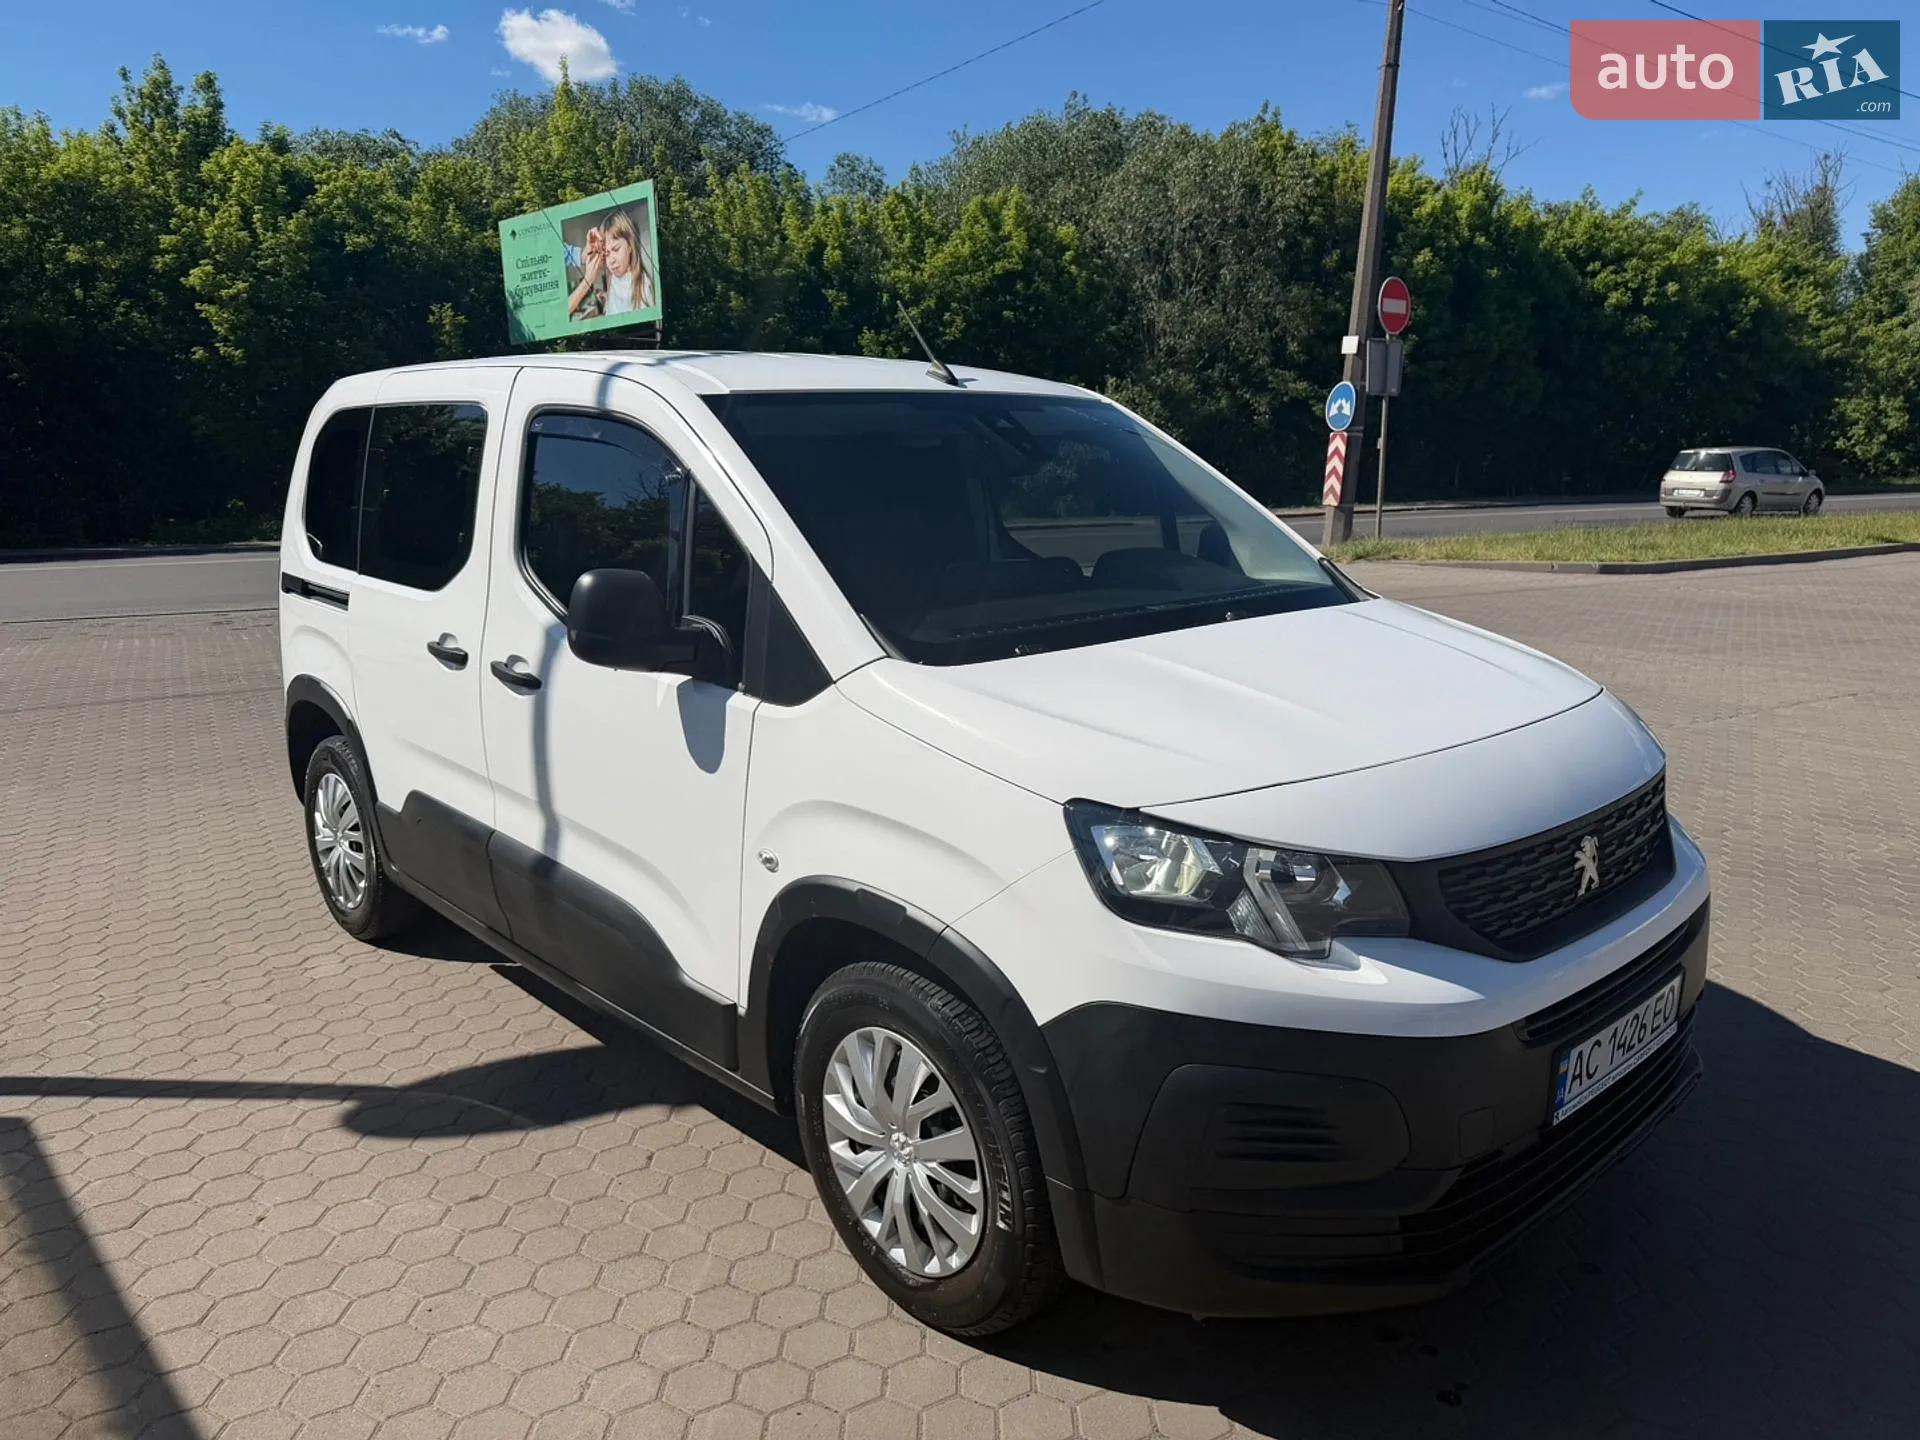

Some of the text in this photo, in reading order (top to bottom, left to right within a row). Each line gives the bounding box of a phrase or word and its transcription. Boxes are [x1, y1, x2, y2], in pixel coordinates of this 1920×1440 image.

[1568, 1040, 1602, 1094] AC
[1608, 1004, 1650, 1065] 1426
[1651, 985, 1675, 1034] EO
